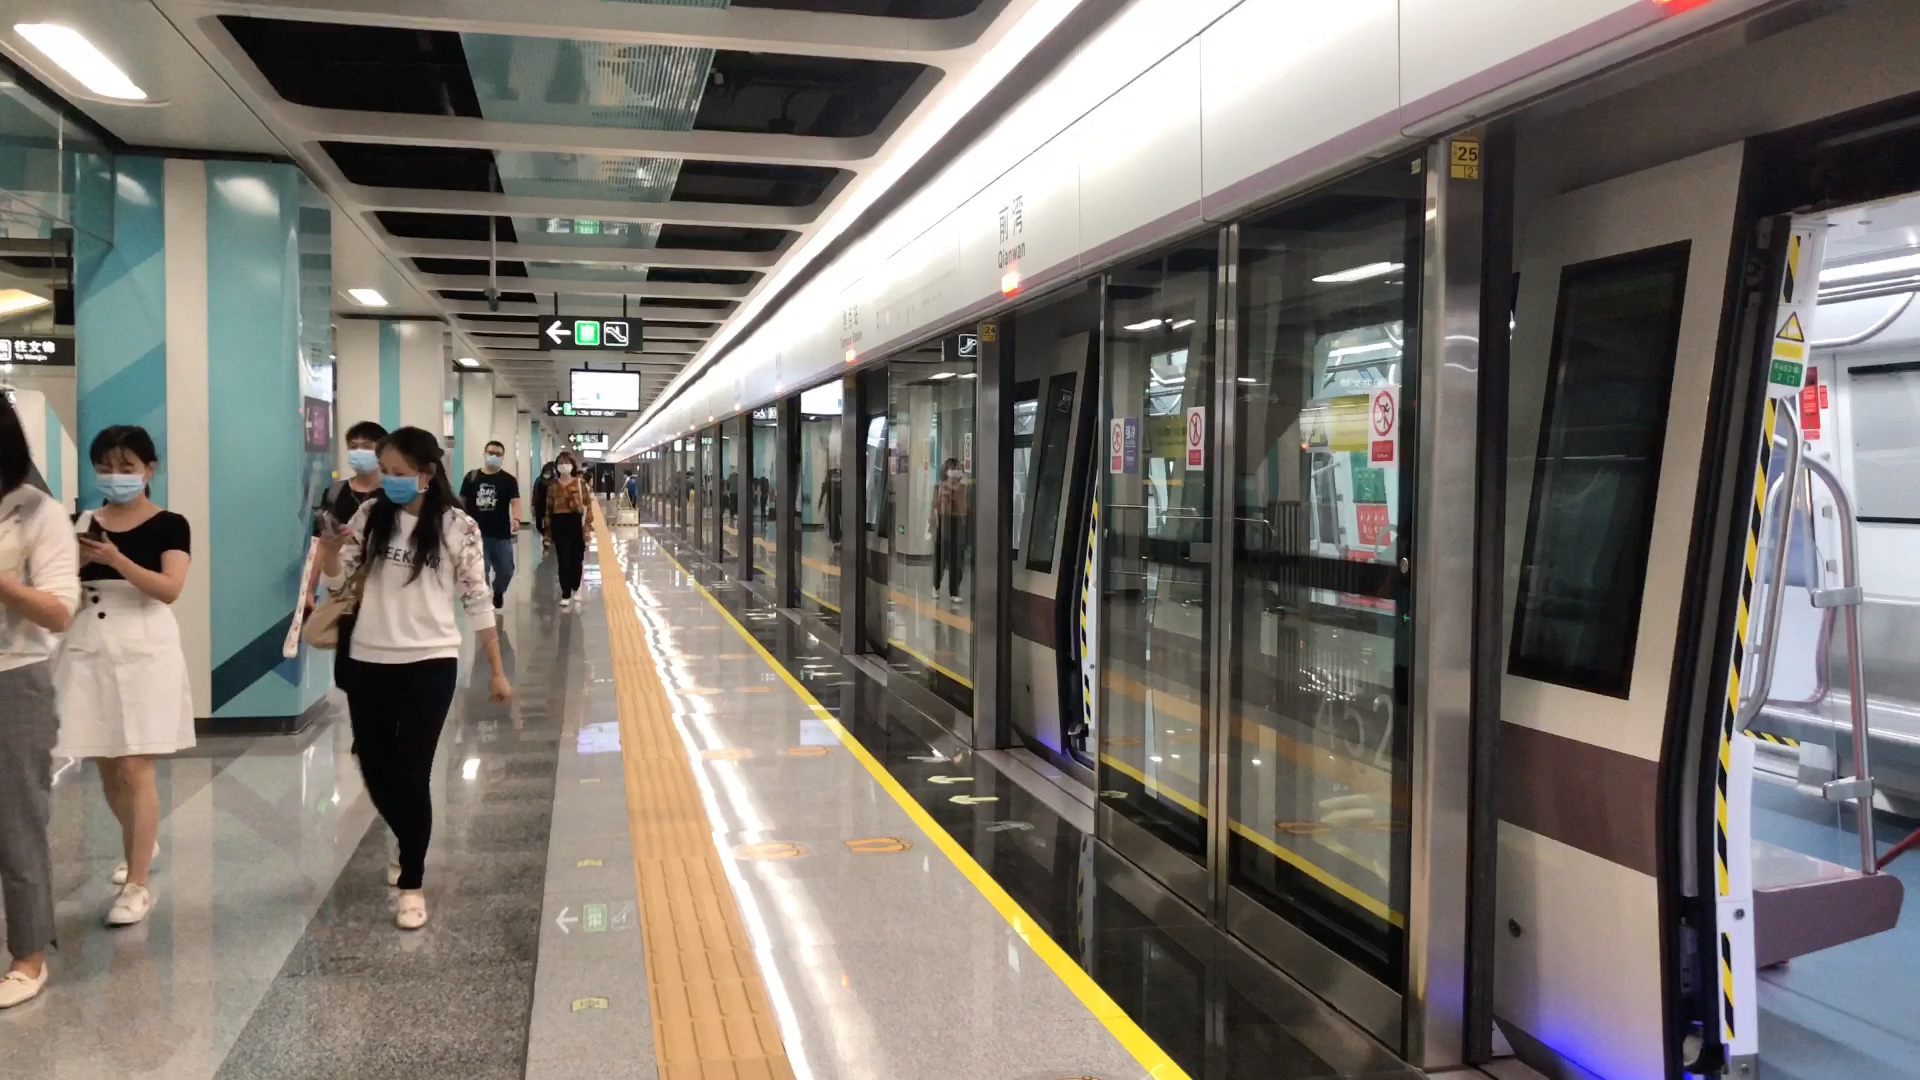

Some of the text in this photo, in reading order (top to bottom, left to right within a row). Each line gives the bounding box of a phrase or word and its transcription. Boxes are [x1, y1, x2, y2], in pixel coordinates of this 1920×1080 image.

[1457, 146, 1478, 162] 25
[998, 192, 1024, 245] 前湾
[997, 242, 1026, 269] Qianwan
[985, 325, 996, 334] 24
[14, 339, 56, 353] 往文
